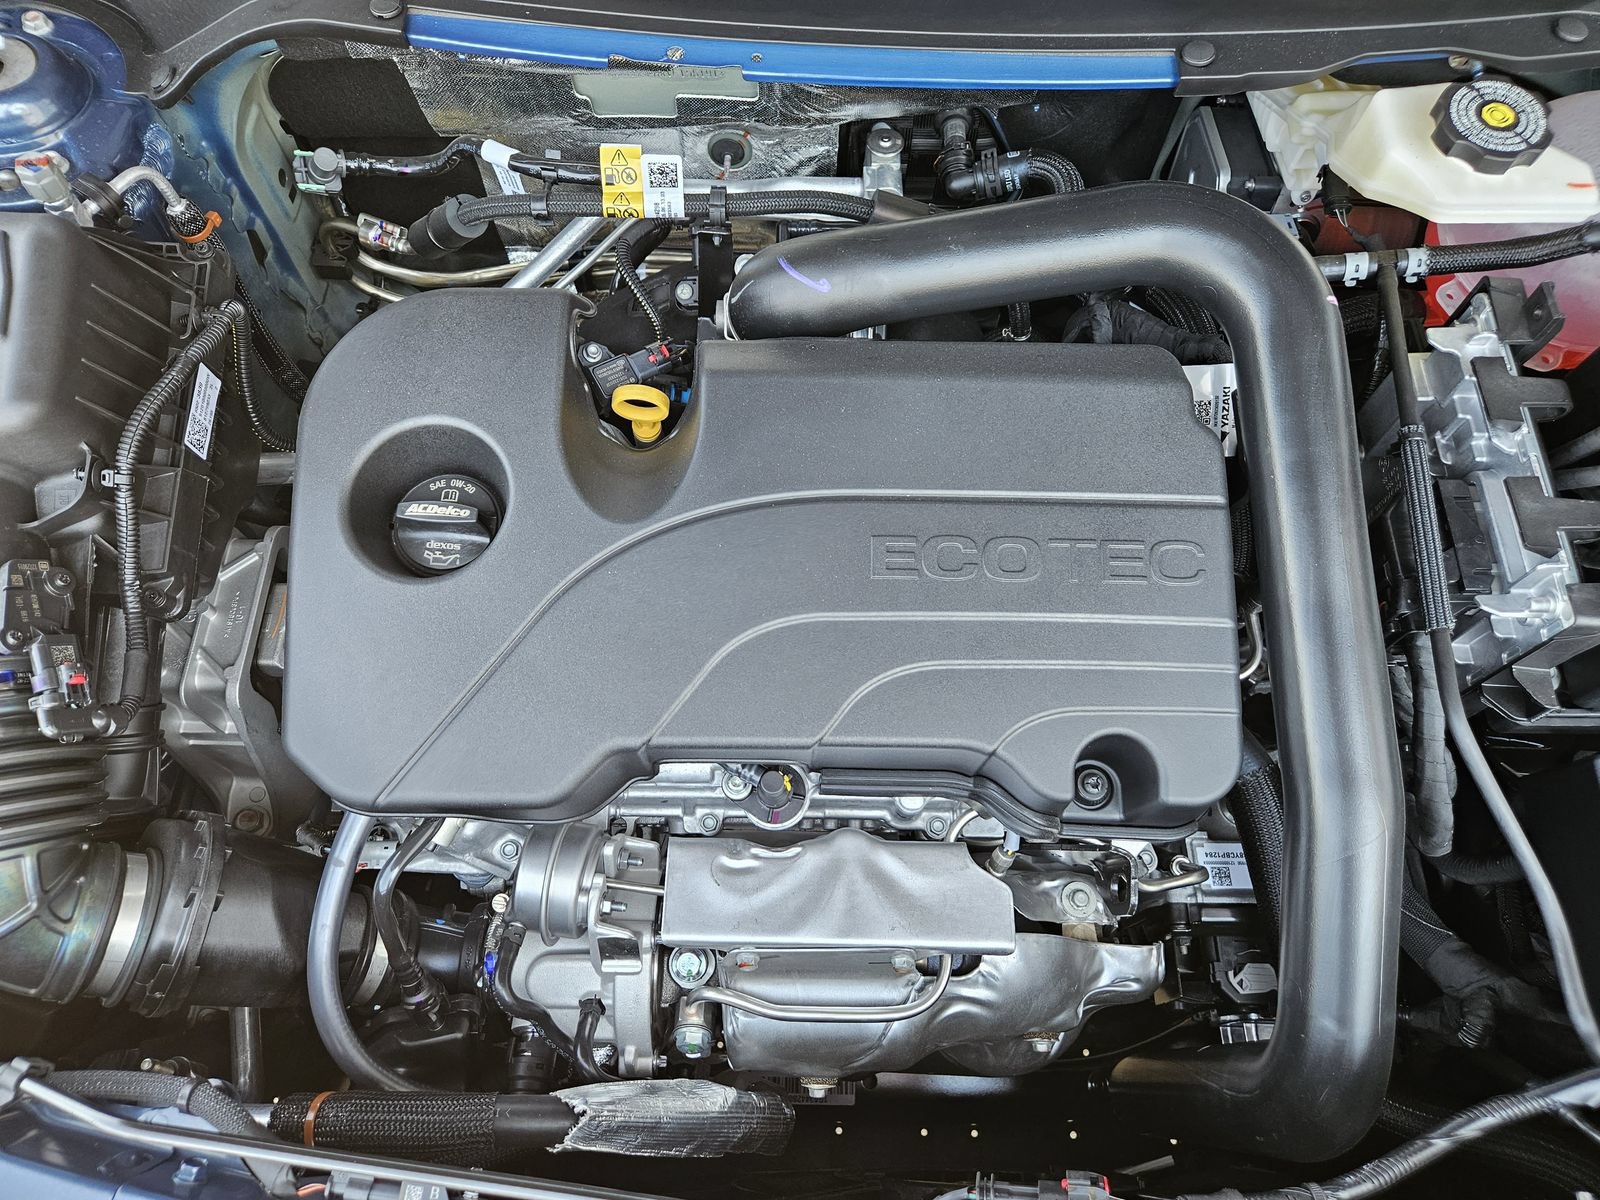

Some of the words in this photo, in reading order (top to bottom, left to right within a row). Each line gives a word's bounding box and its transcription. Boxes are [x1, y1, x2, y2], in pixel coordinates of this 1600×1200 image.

[1220, 386, 1231, 429] YAZAKI
[429, 479, 446, 491] SAE
[450, 479, 476, 494] 0W-20
[404, 503, 471, 517] ACDelco
[425, 540, 461, 550] dexos
[870, 534, 1206, 585] ECOTEC
